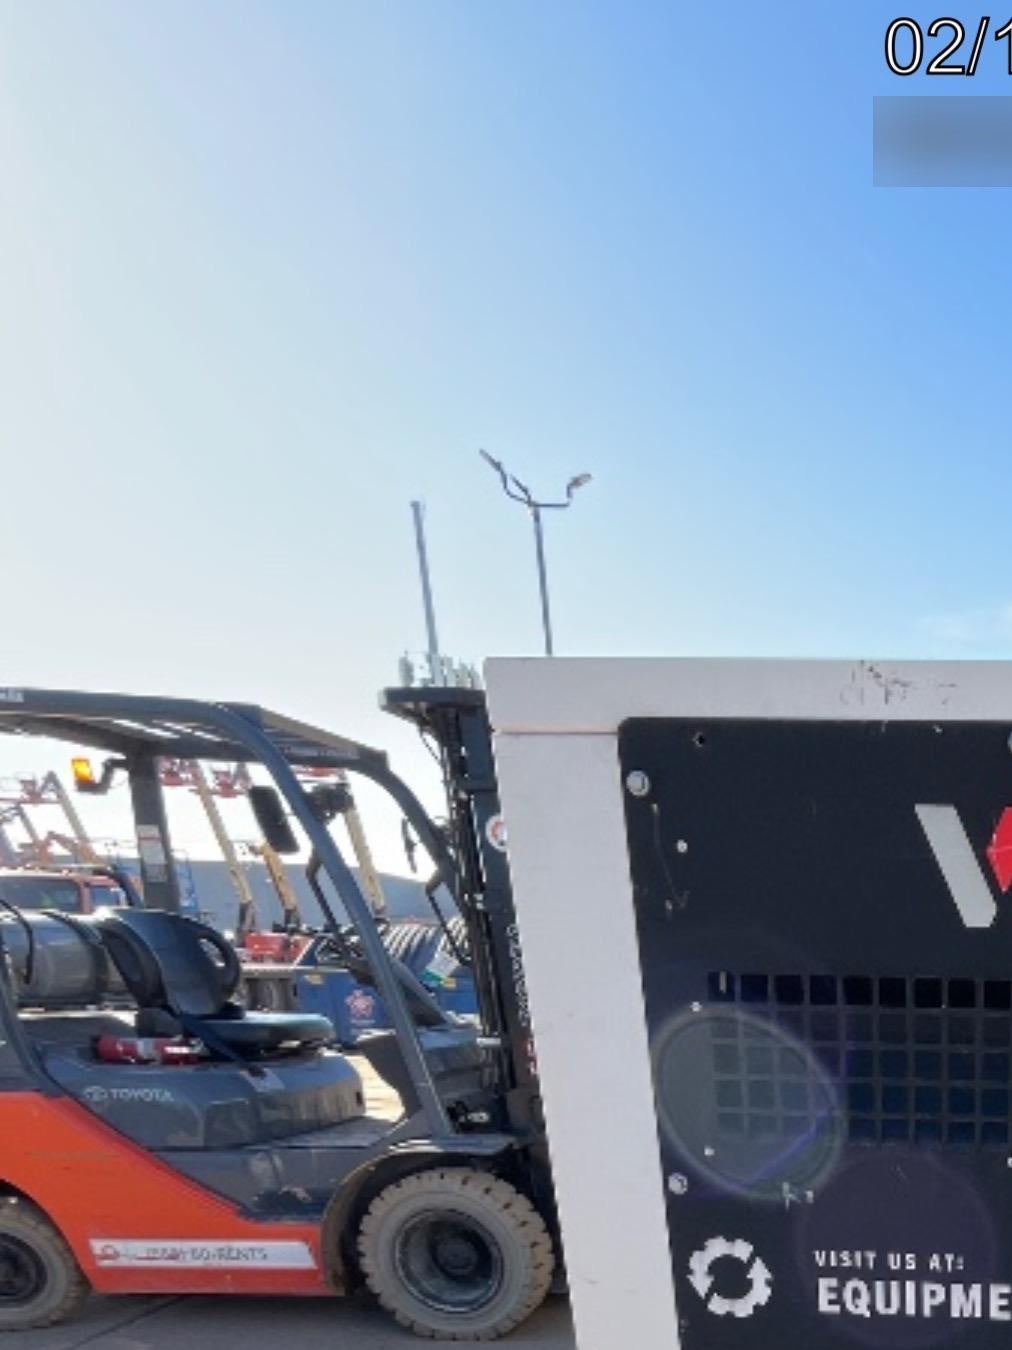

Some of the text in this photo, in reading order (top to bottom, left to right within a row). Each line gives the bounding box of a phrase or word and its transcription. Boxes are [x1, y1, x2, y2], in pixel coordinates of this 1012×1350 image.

[110, 1087, 175, 1102] TOYOTA
[814, 1250, 965, 1273] VISIT US AT:
